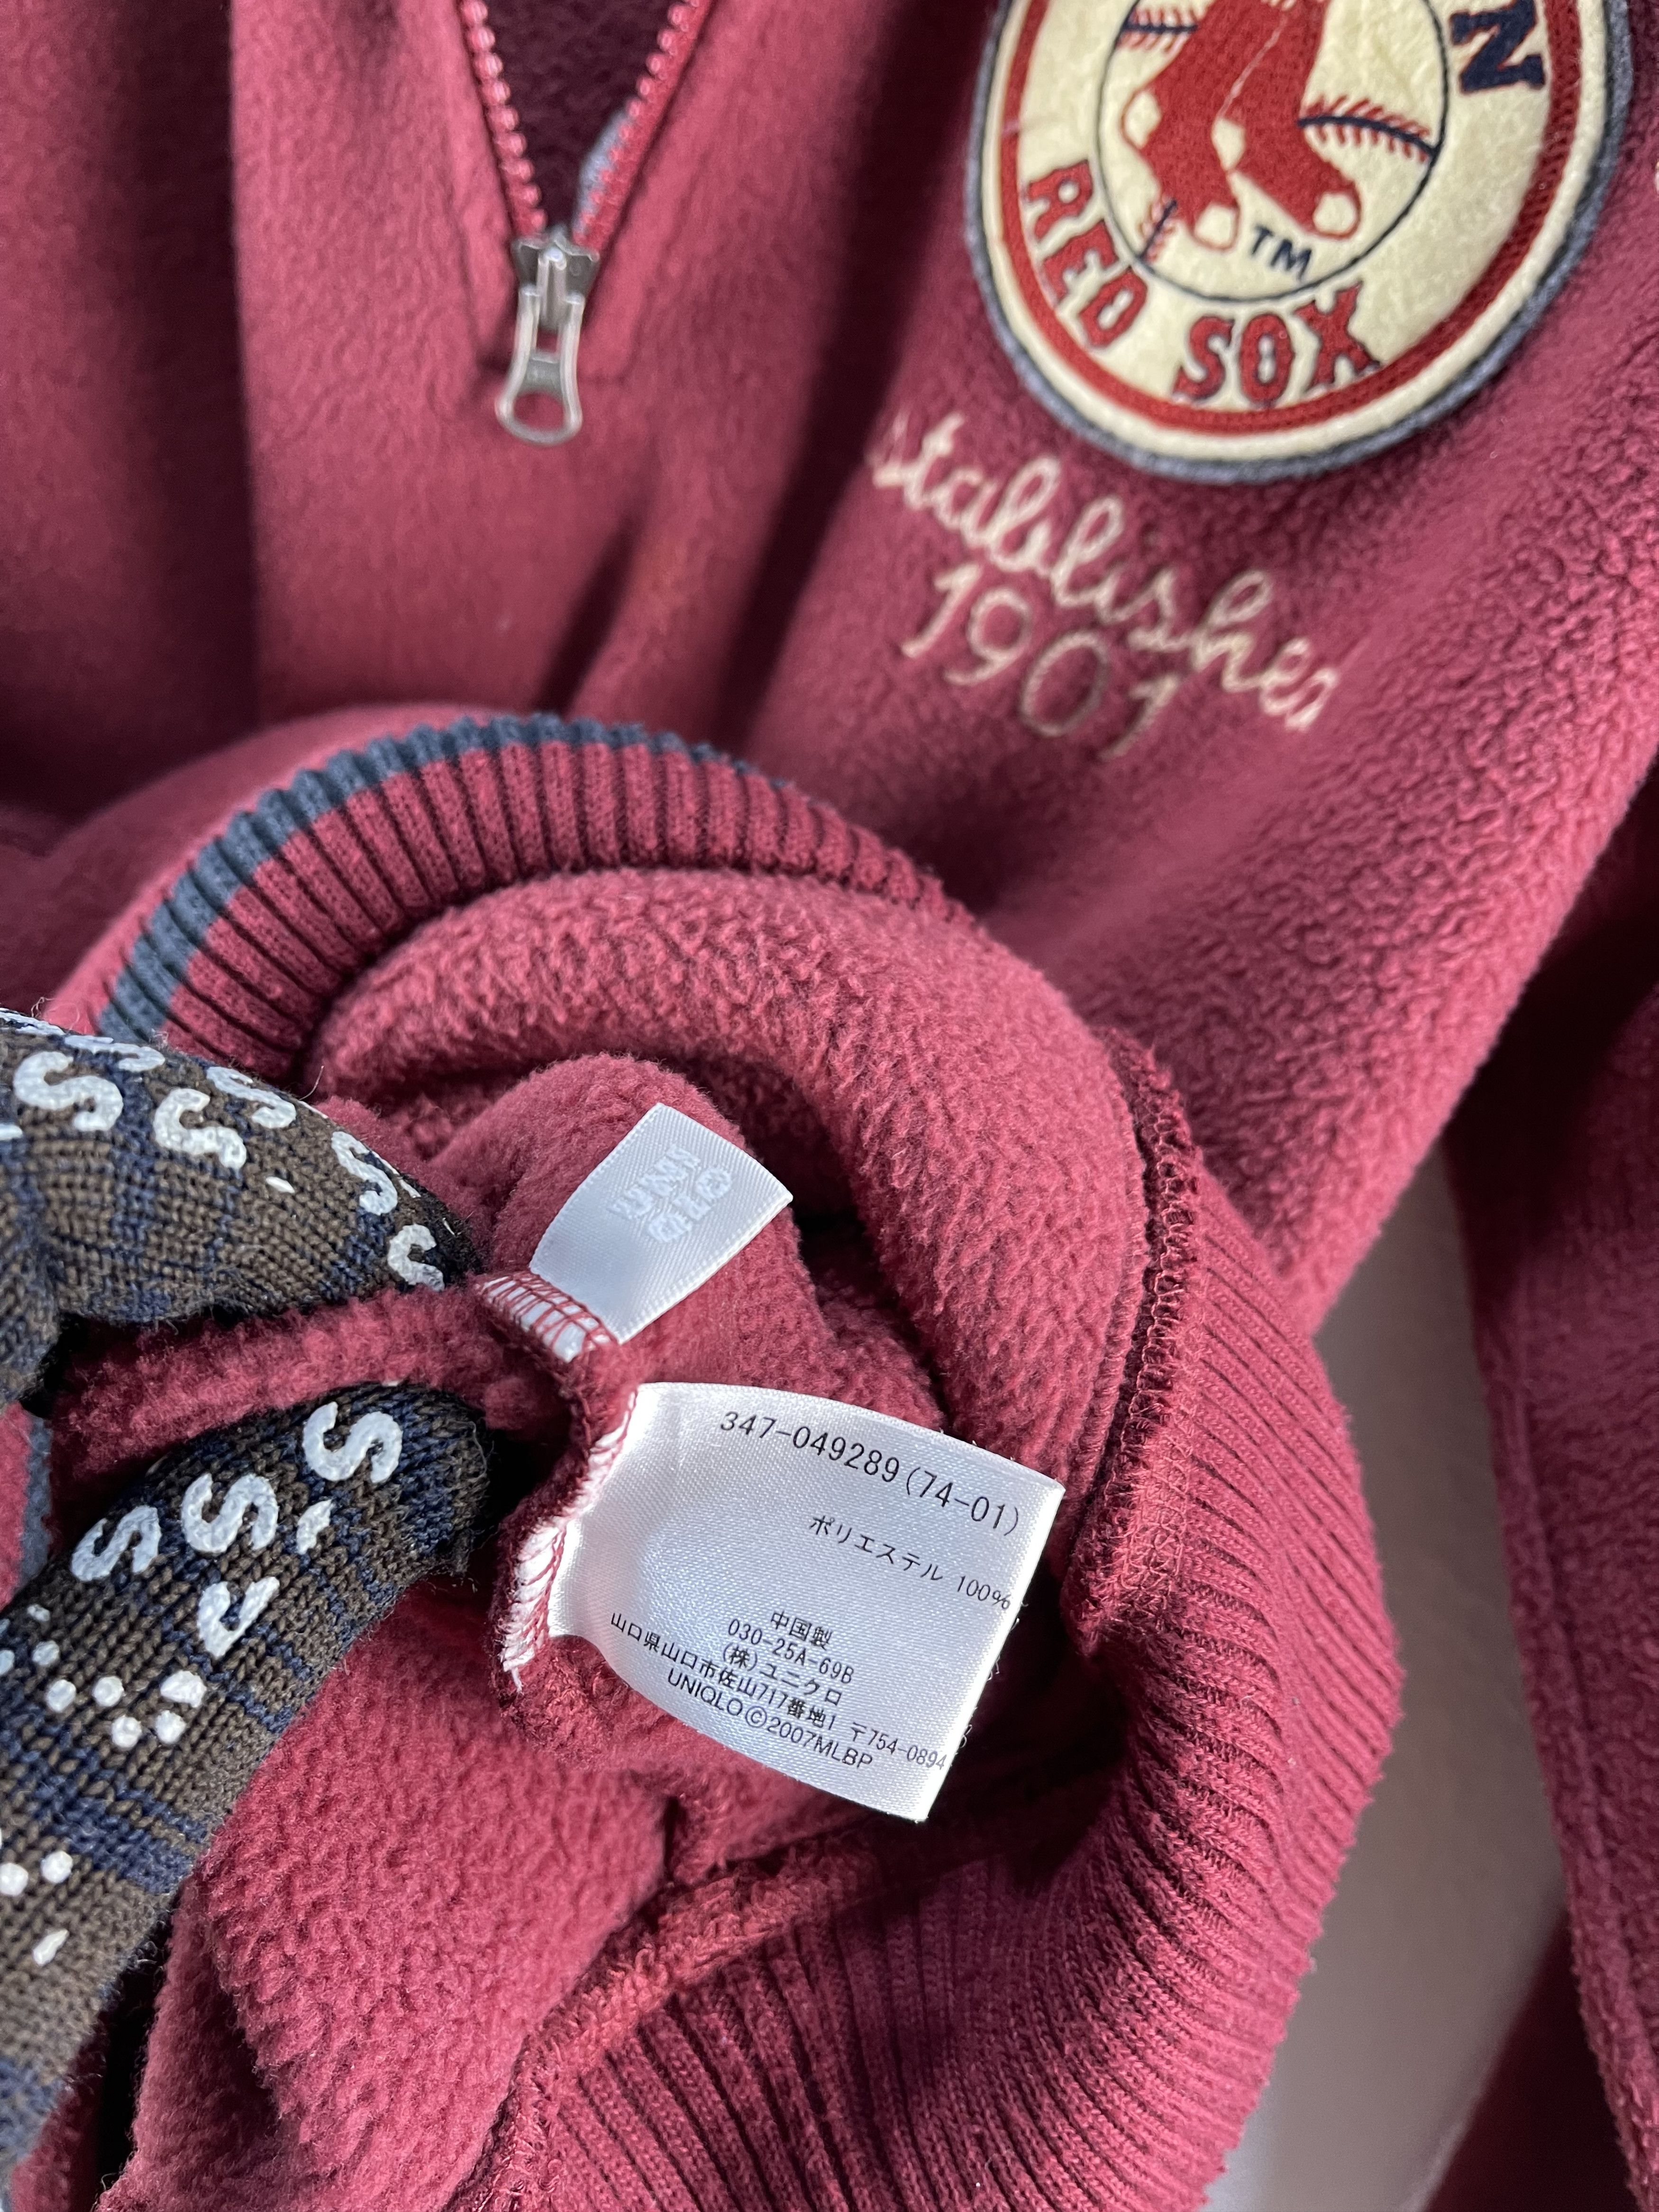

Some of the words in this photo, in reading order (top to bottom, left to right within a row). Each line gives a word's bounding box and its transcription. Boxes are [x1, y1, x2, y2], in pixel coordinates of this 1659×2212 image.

[1026, 159, 1148, 351] RED
[1173, 280, 1381, 409] SOX
[809, 1515, 943, 1581] ポリエステル
[956, 1575, 1012, 1610] 100%
[728, 1619, 855, 1684] 030-25A-69B
[770, 1611, 833, 1650] 中国製
